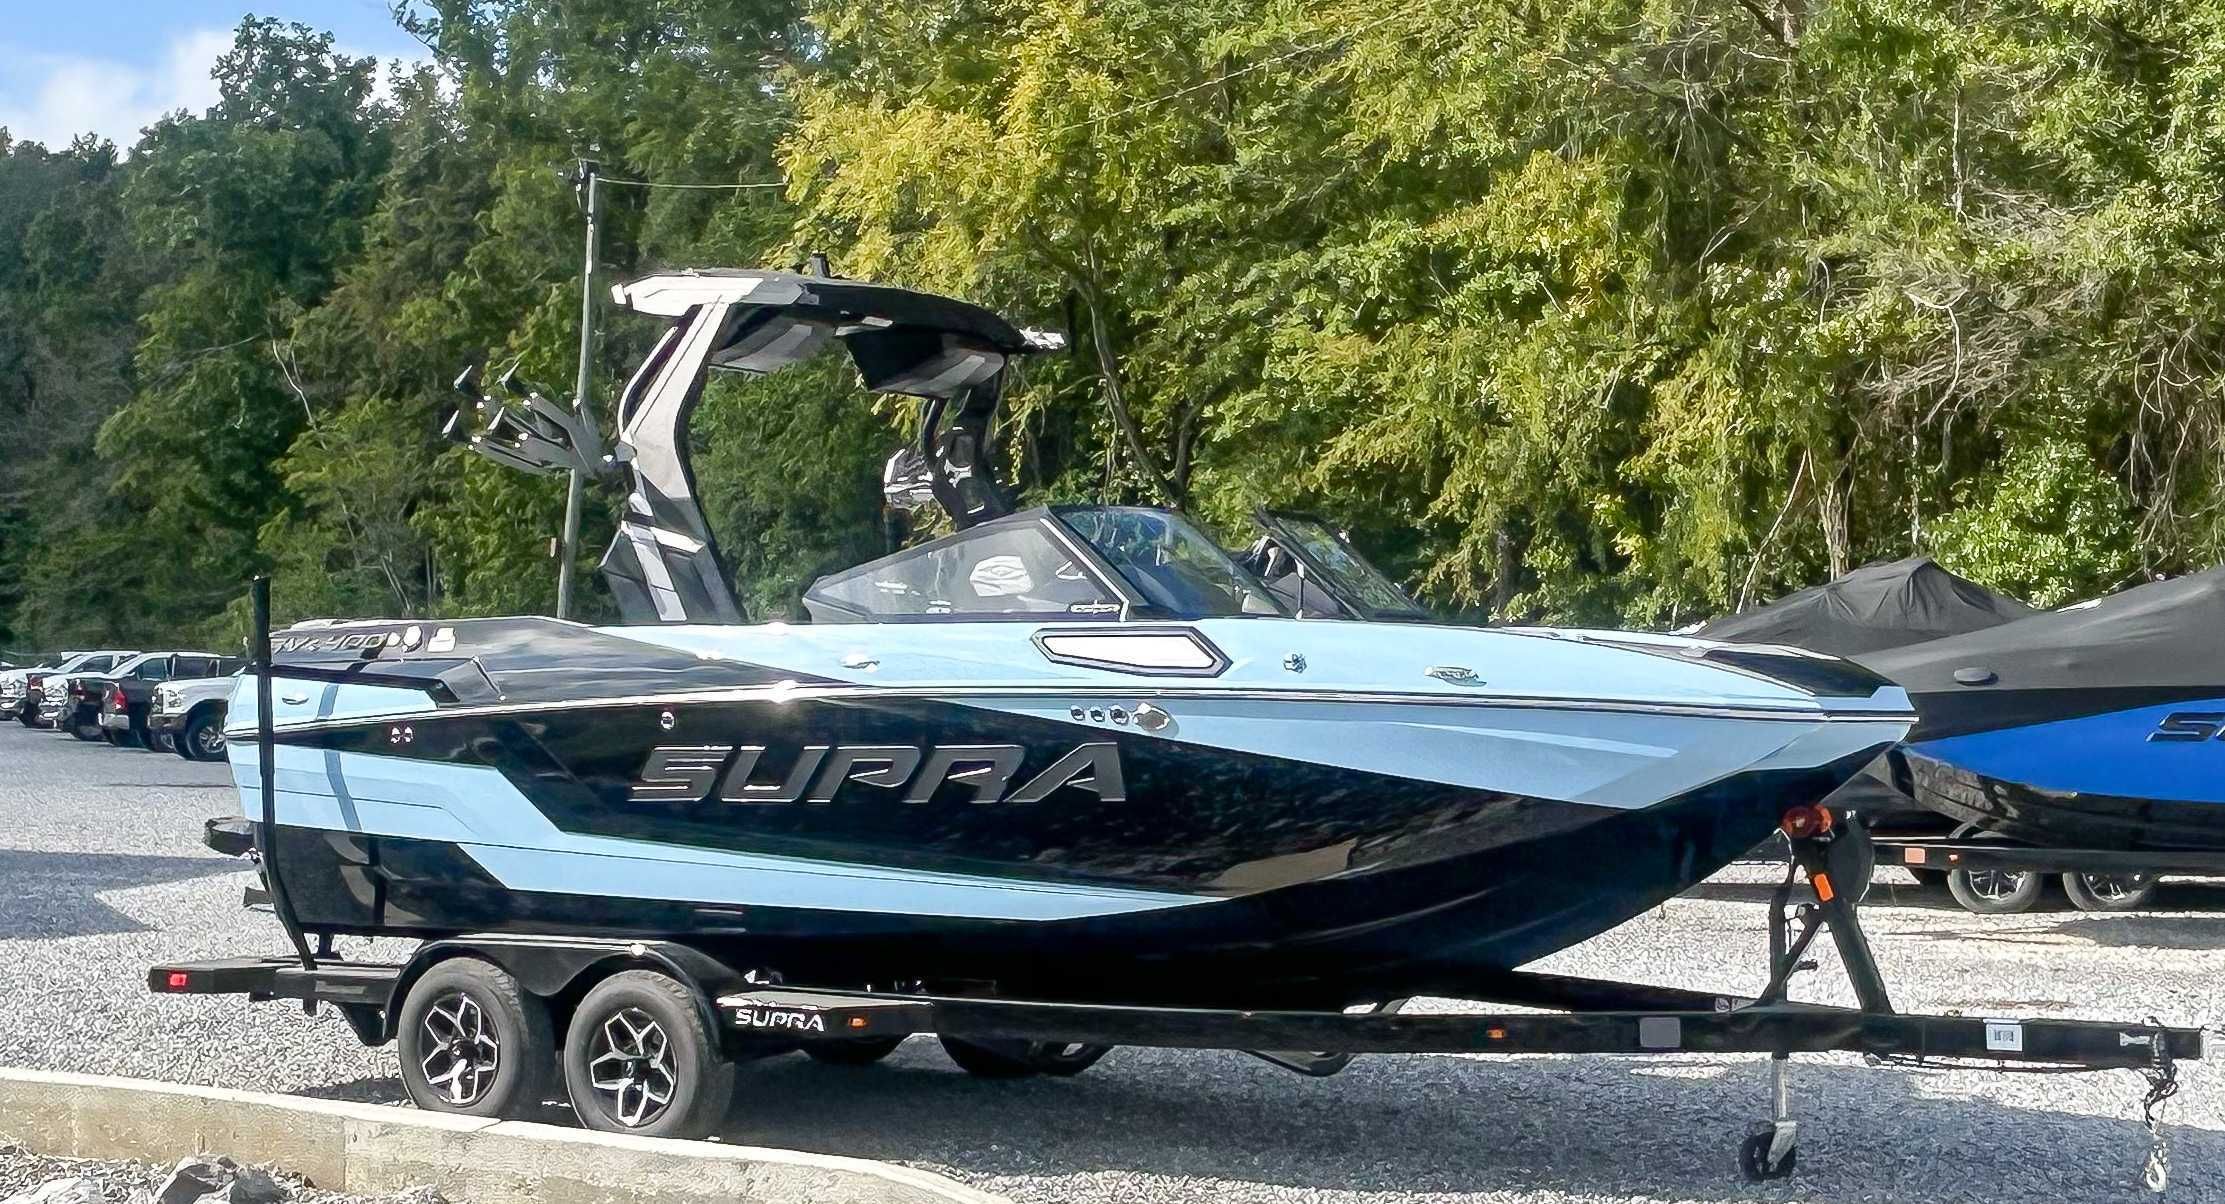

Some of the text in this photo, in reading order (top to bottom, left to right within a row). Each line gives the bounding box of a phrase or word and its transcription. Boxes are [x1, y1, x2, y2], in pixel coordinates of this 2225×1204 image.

[2144, 711, 2225, 743] S
[626, 743, 1126, 804] SUPRA
[735, 1008, 825, 1032] SUPRA
